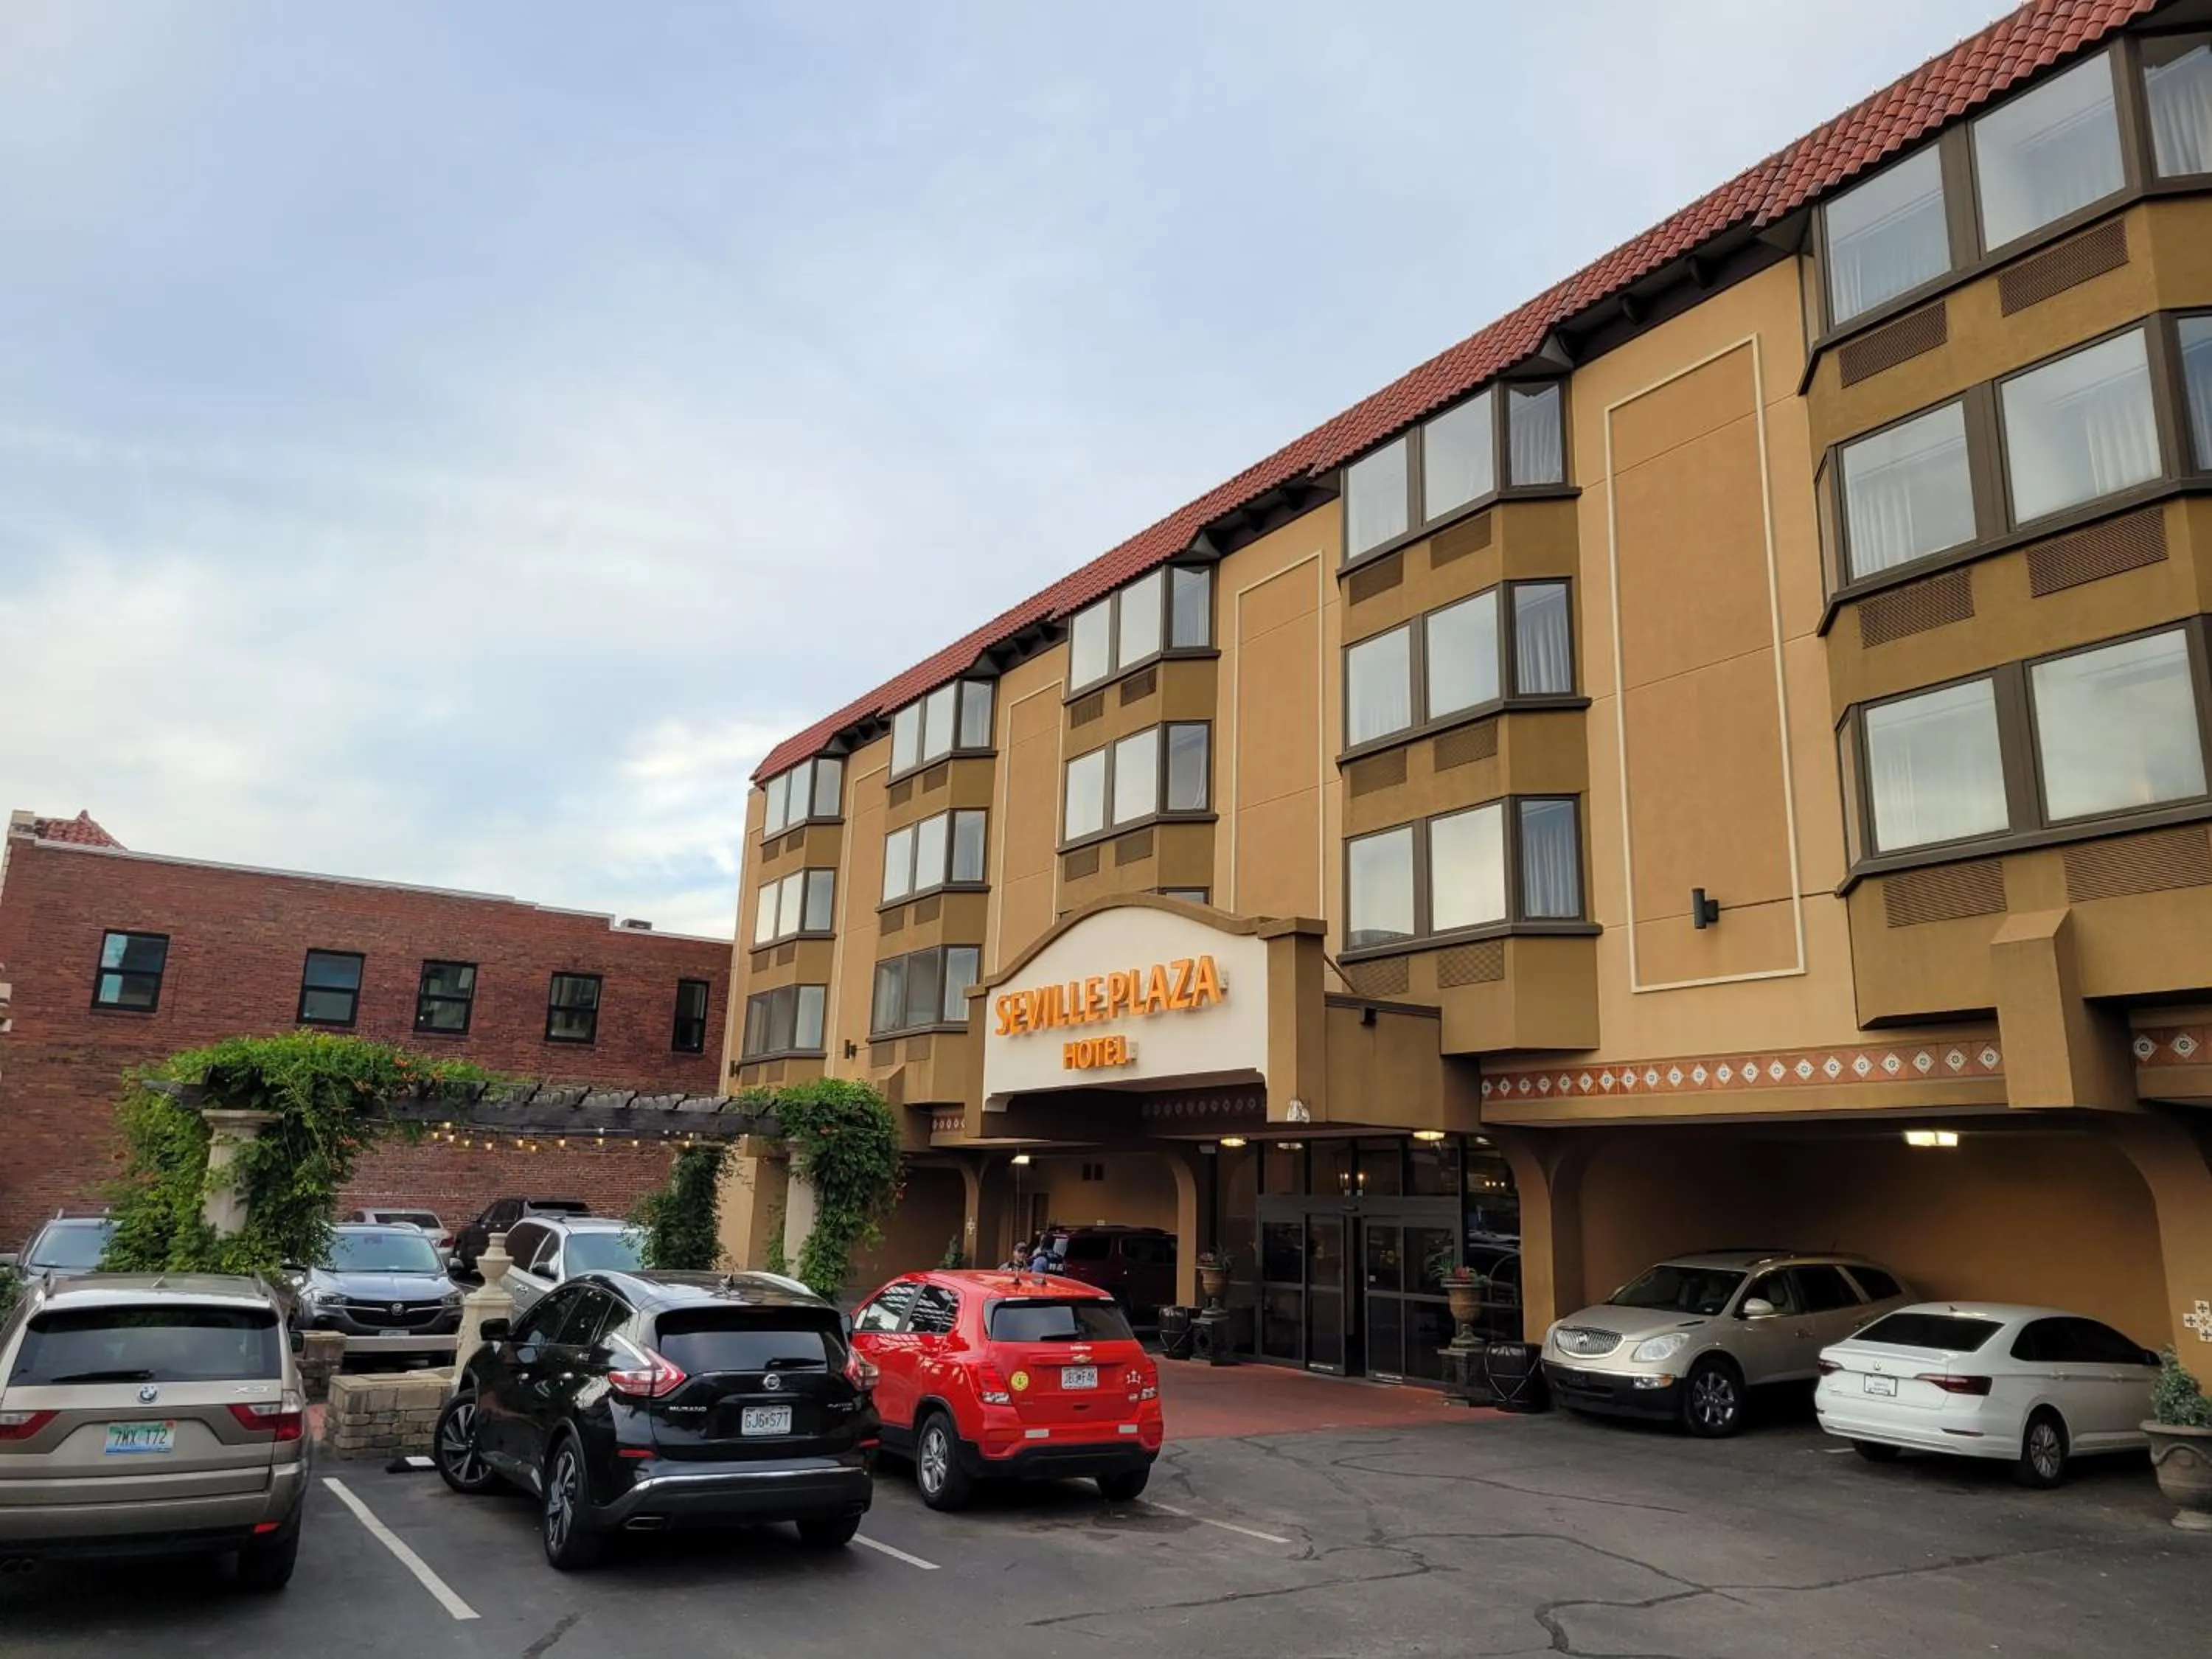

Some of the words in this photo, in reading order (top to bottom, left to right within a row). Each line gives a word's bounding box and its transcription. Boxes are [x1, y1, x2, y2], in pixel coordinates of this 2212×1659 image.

[995, 975, 1104, 1036] SEVILLE
[1107, 955, 1223, 1017] PLAZA
[1062, 1035, 1127, 1069] HOTEL
